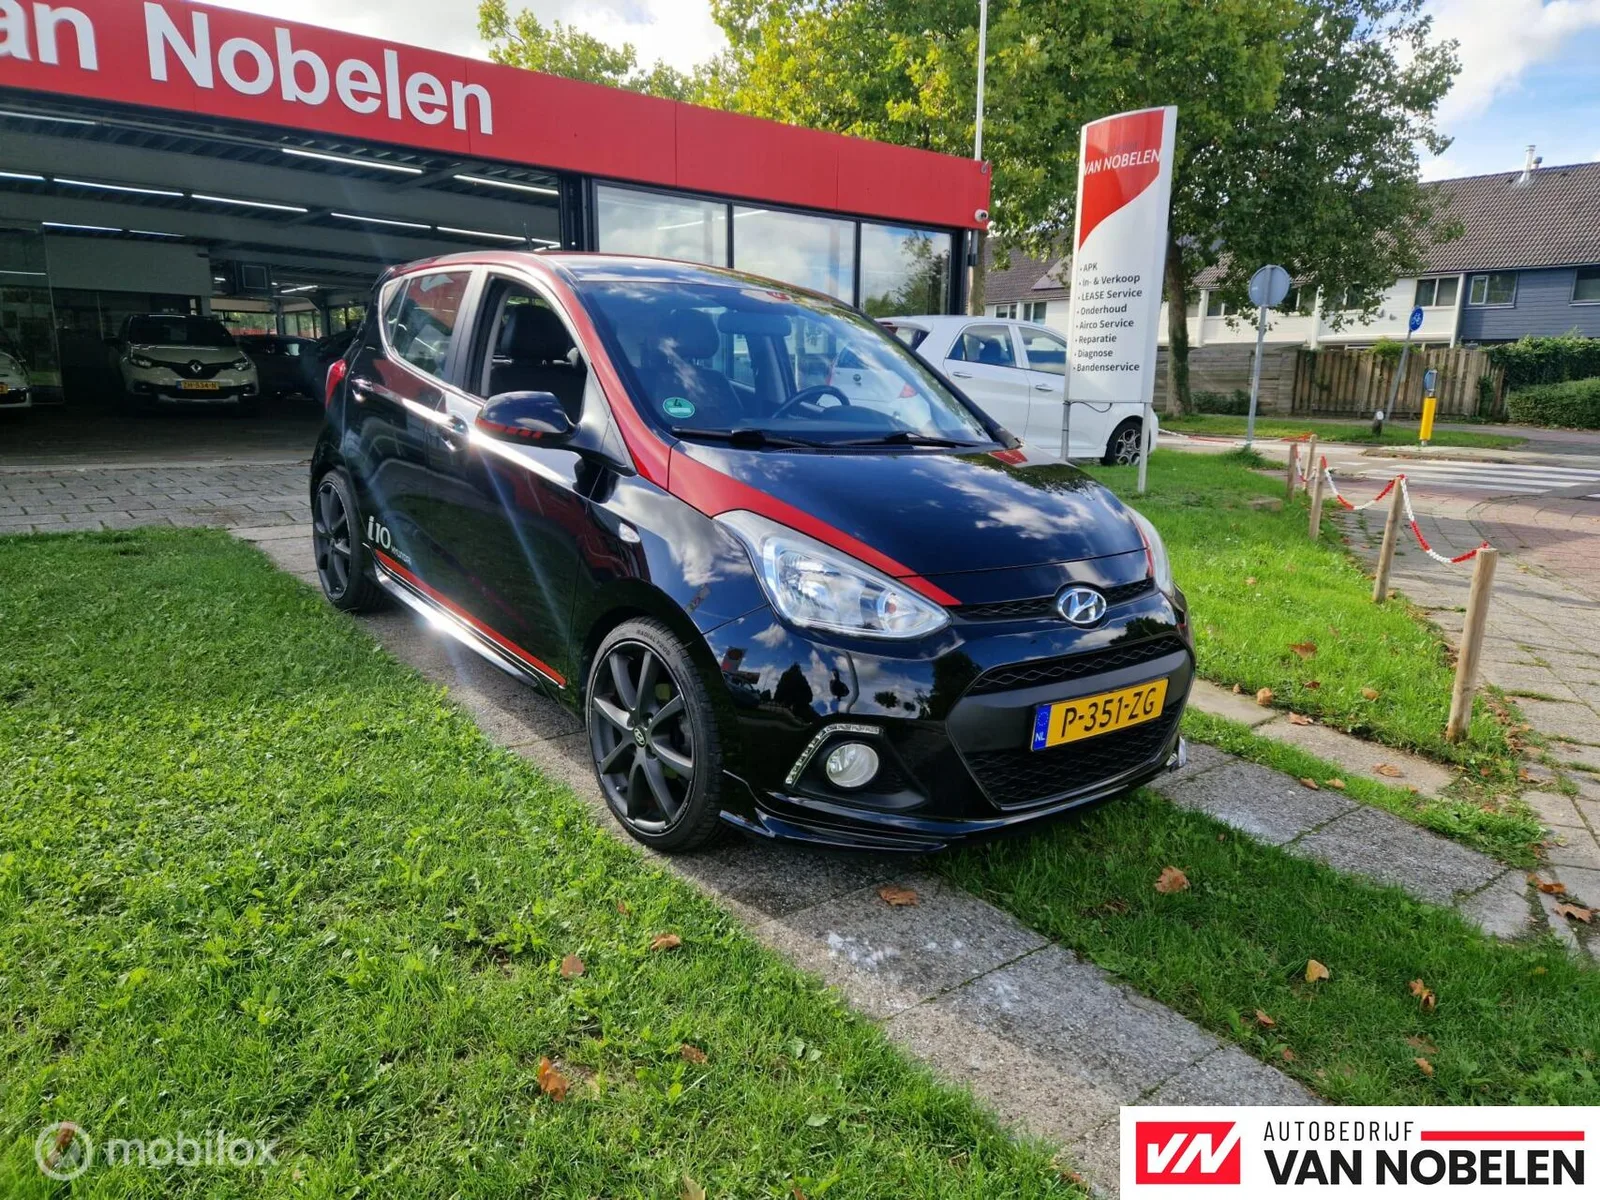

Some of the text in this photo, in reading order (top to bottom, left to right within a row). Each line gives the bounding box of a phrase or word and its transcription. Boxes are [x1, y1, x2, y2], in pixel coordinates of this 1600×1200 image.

[144, 2, 494, 135] Nobelen
[1083, 149, 1161, 175] VAN NOBELEN
[1101, 274, 1141, 285] Verkoop
[1081, 288, 1143, 301] LEASE Service
[1080, 304, 1127, 315] Onderhoud
[1099, 318, 1134, 328] Service
[1078, 333, 1117, 345] Reparatie
[1077, 350, 1114, 359] Diagnose
[1076, 362, 1140, 371] Bandenservice
[367, 515, 391, 549] i10
[1061, 687, 1157, 738] P-351-ZG
[1034, 732, 1046, 742] NL
